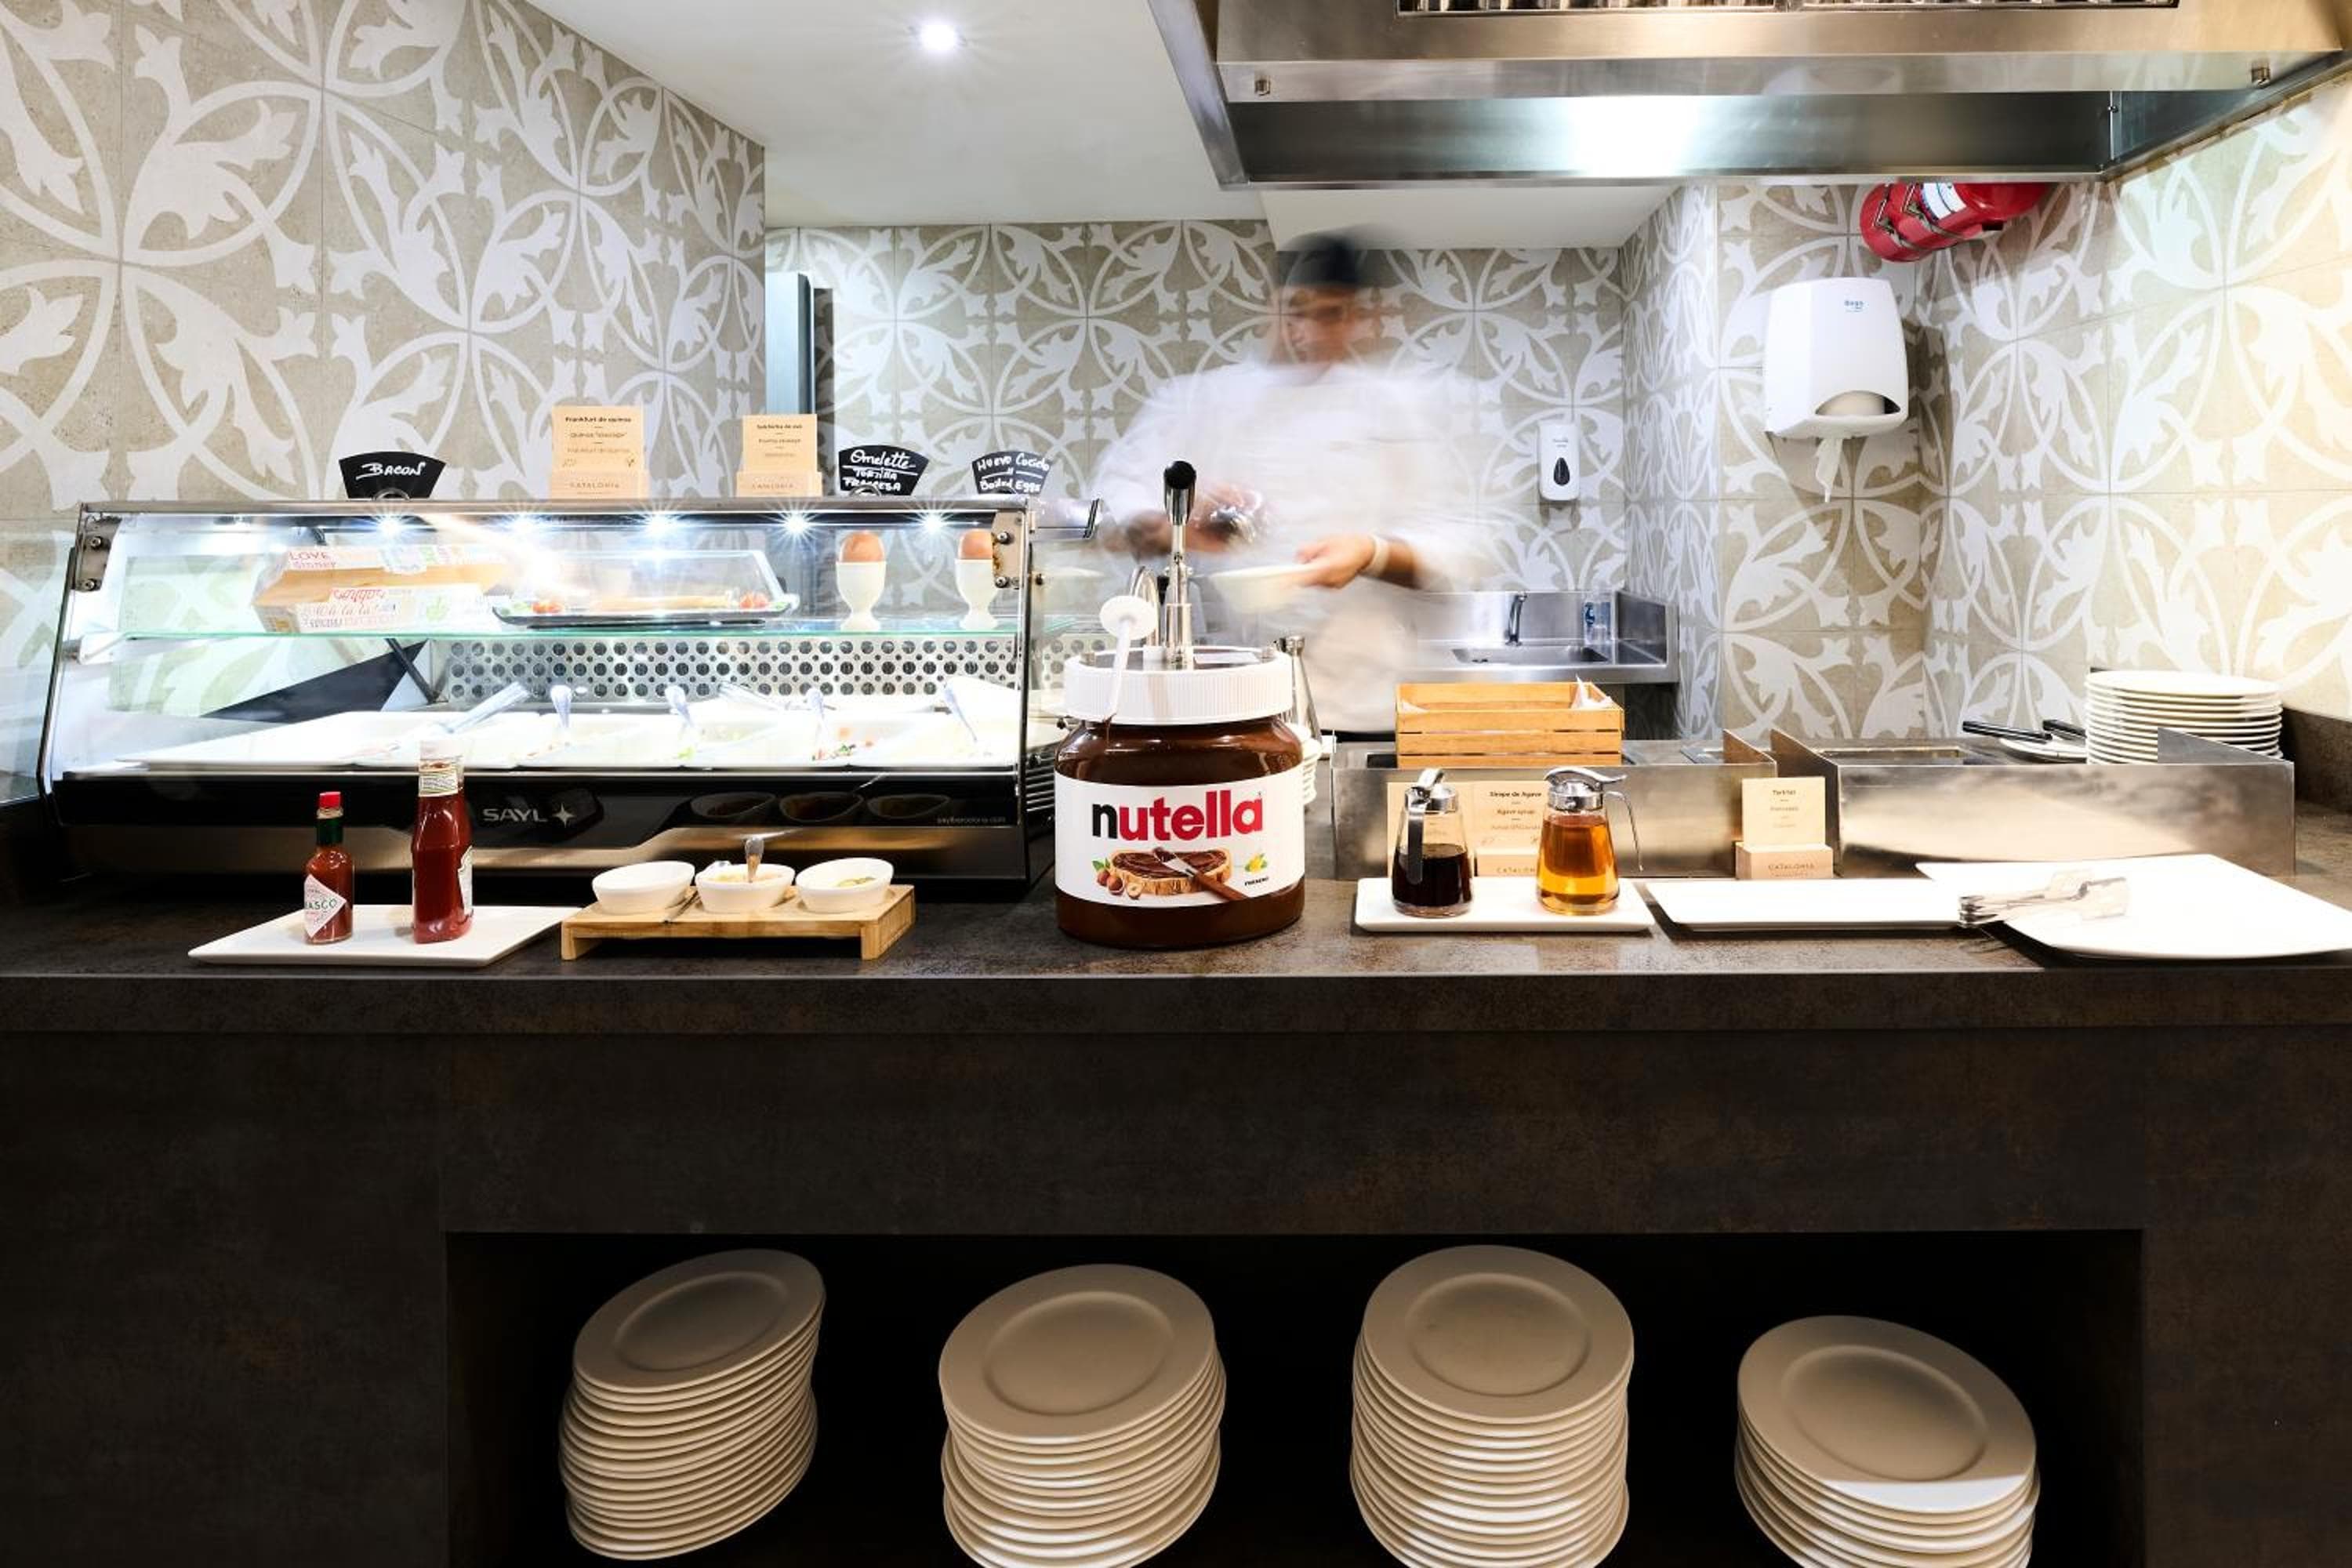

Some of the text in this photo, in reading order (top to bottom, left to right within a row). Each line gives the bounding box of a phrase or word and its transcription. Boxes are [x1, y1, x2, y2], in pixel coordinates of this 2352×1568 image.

[850, 449, 912, 470] Omelette
[356, 461, 426, 481] BACON
[482, 808, 548, 822] SAYL
[1092, 789, 1263, 841] nutella
